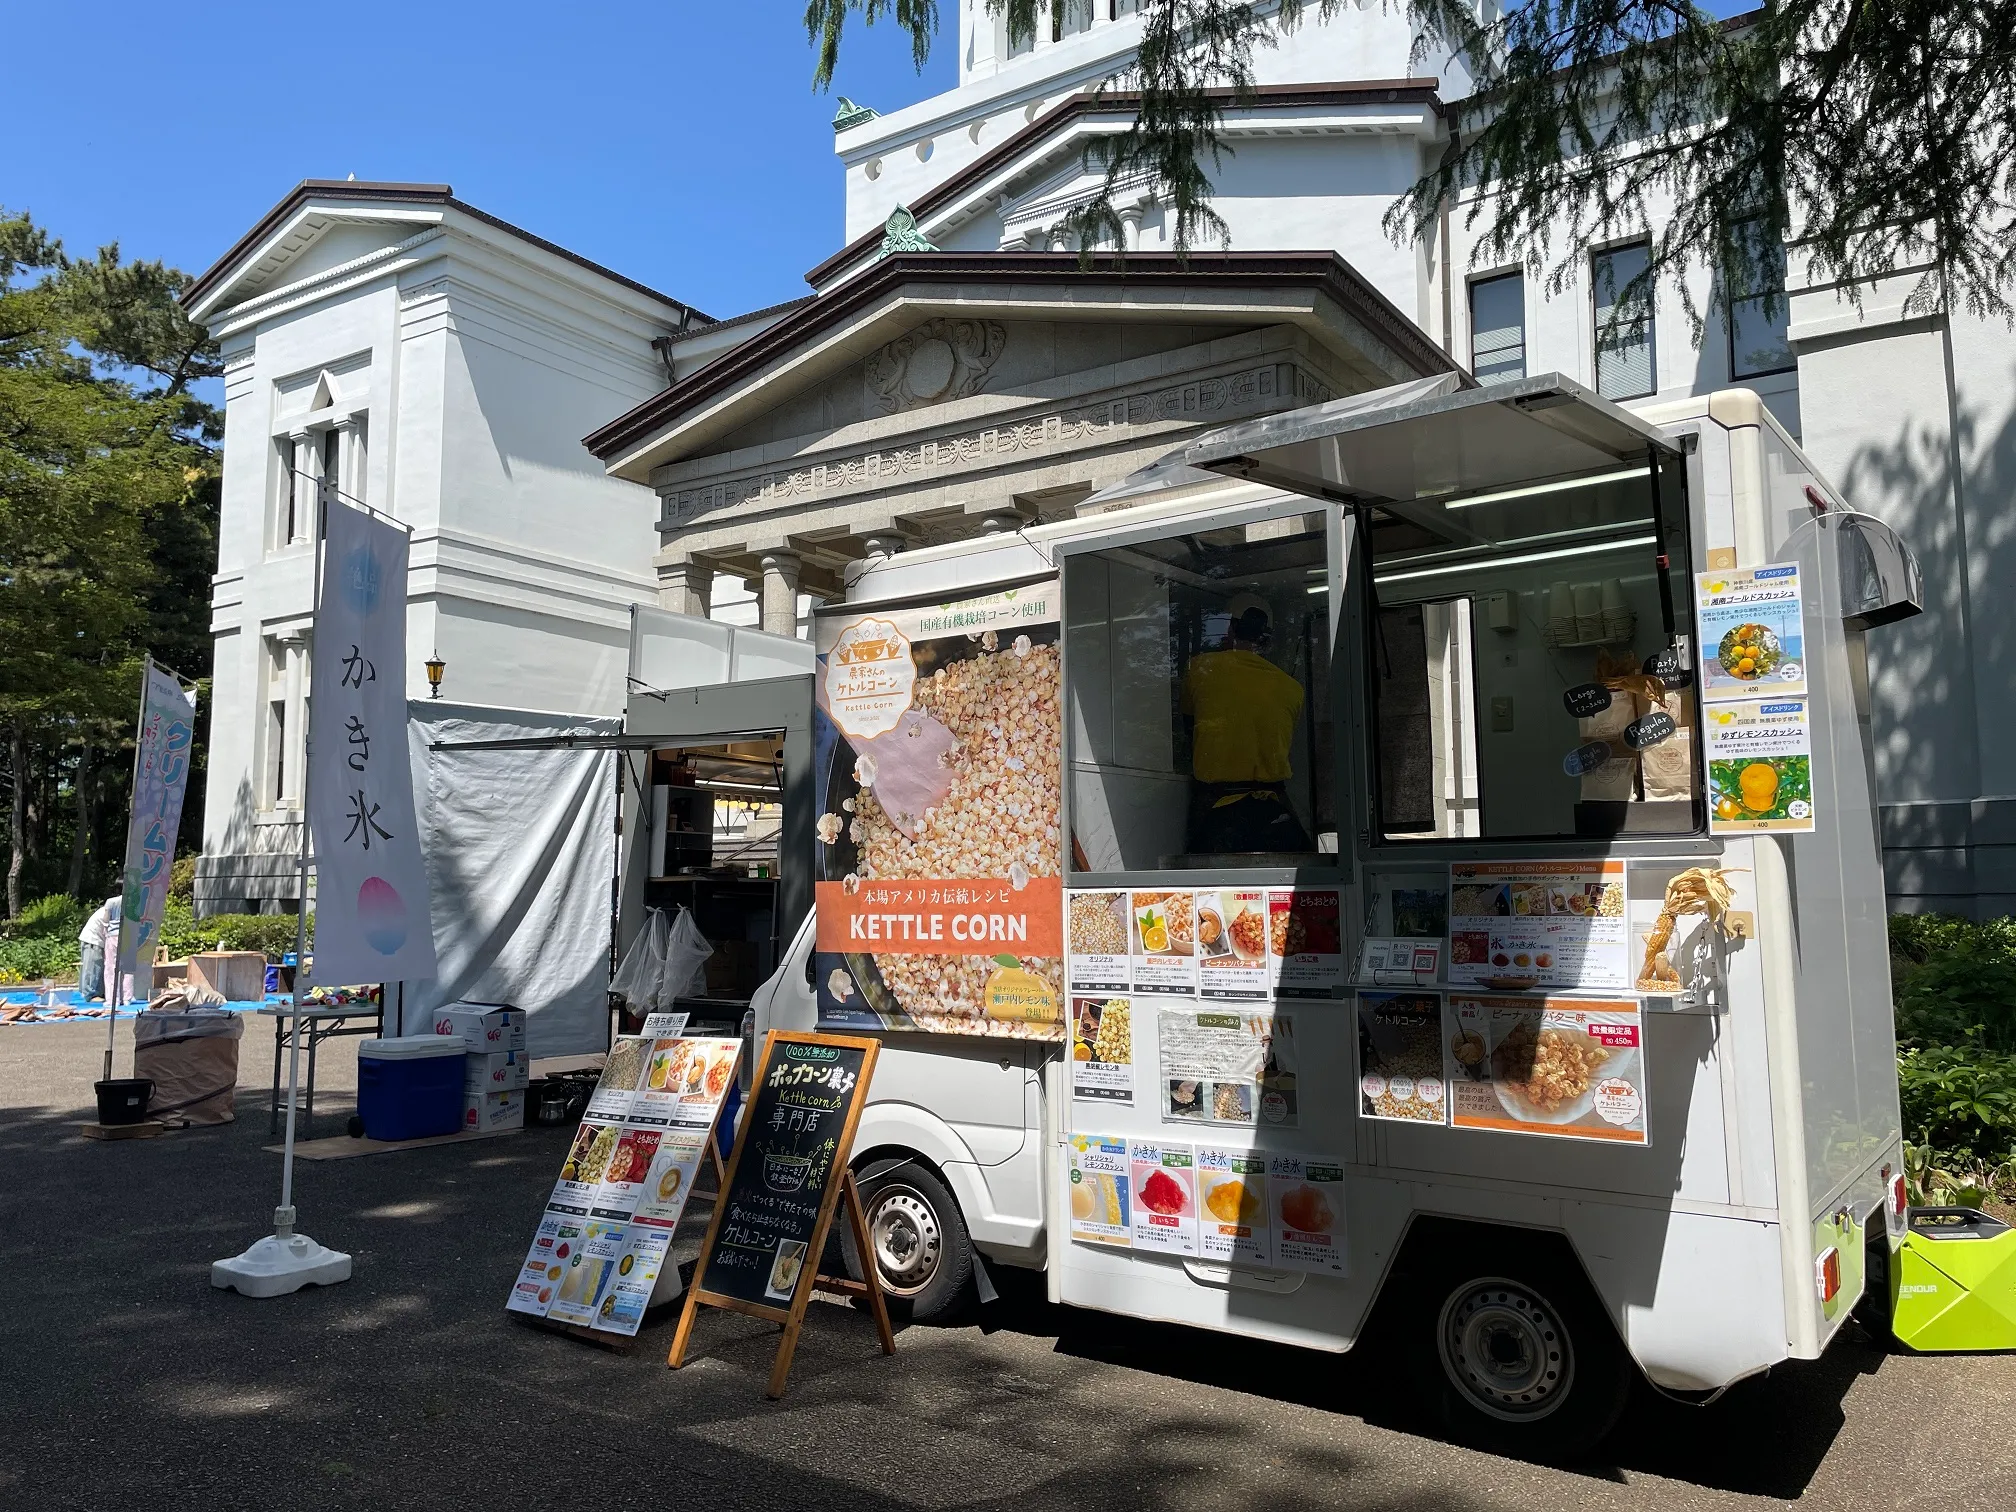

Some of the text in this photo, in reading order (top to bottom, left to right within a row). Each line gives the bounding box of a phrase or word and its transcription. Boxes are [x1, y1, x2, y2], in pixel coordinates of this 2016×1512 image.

[1756, 569, 1793, 578] アイスドリンク
[1711, 590, 1795, 606] 湘南ゴールドスカッシュ
[920, 601, 1046, 632] 国産有機栽培コーン使用
[1650, 657, 1677, 669] Party
[849, 667, 886, 679] 農家さんの
[837, 678, 897, 695] ケトルコーン
[1568, 689, 1596, 704] Large
[845, 702, 893, 712] Kettle Corn
[1762, 704, 1799, 713] アイスドリンク
[1628, 715, 1667, 738] Regular
[1721, 728, 1803, 740] ゆずレモンスカッシュ
[341, 644, 394, 850] かき氷
[1568, 748, 1602, 766] Single
[864, 888, 1010, 905] 本場アメリカ伝統レシピ
[1300, 896, 1338, 906] とちおとめ
[850, 914, 1027, 941] KETTLE CORN
[1400, 943, 1413, 951] Pay
[1491, 936, 1504, 950] 氷
[1508, 941, 1537, 949] かき氷
[1205, 960, 1258, 968] ピーナッツバター味
[993, 994, 1050, 1006] 瀬戸内レモン味
[1375, 1015, 1427, 1026] ケトルコーン
[1492, 1009, 1586, 1024] ピーナッツバター味
[656, 1029, 680, 1037] できます
[1592, 1026, 1632, 1036] 数量限定品
[788, 1045, 836, 1058] 100%無添加
[769, 1063, 856, 1094] ポップコーン菓子
[1392, 1079, 1411, 1087] 100%
[1391, 1087, 1413, 1095] 無添加
[1420, 1084, 1441, 1096] できたて
[779, 1090, 829, 1108] Kettle corn
[768, 1107, 820, 1132] 専門店
[669, 1135, 701, 1145] アイスクリーム
[1133, 1144, 1158, 1159] かき氷
[1084, 1154, 1114, 1163] シャリシャリ
[1200, 1150, 1227, 1166] かき氷
[1085, 1162, 1125, 1172] レモンスカッシュ
[1272, 1157, 1301, 1173] かき氷
[724, 1223, 776, 1248] ケトルコーン
